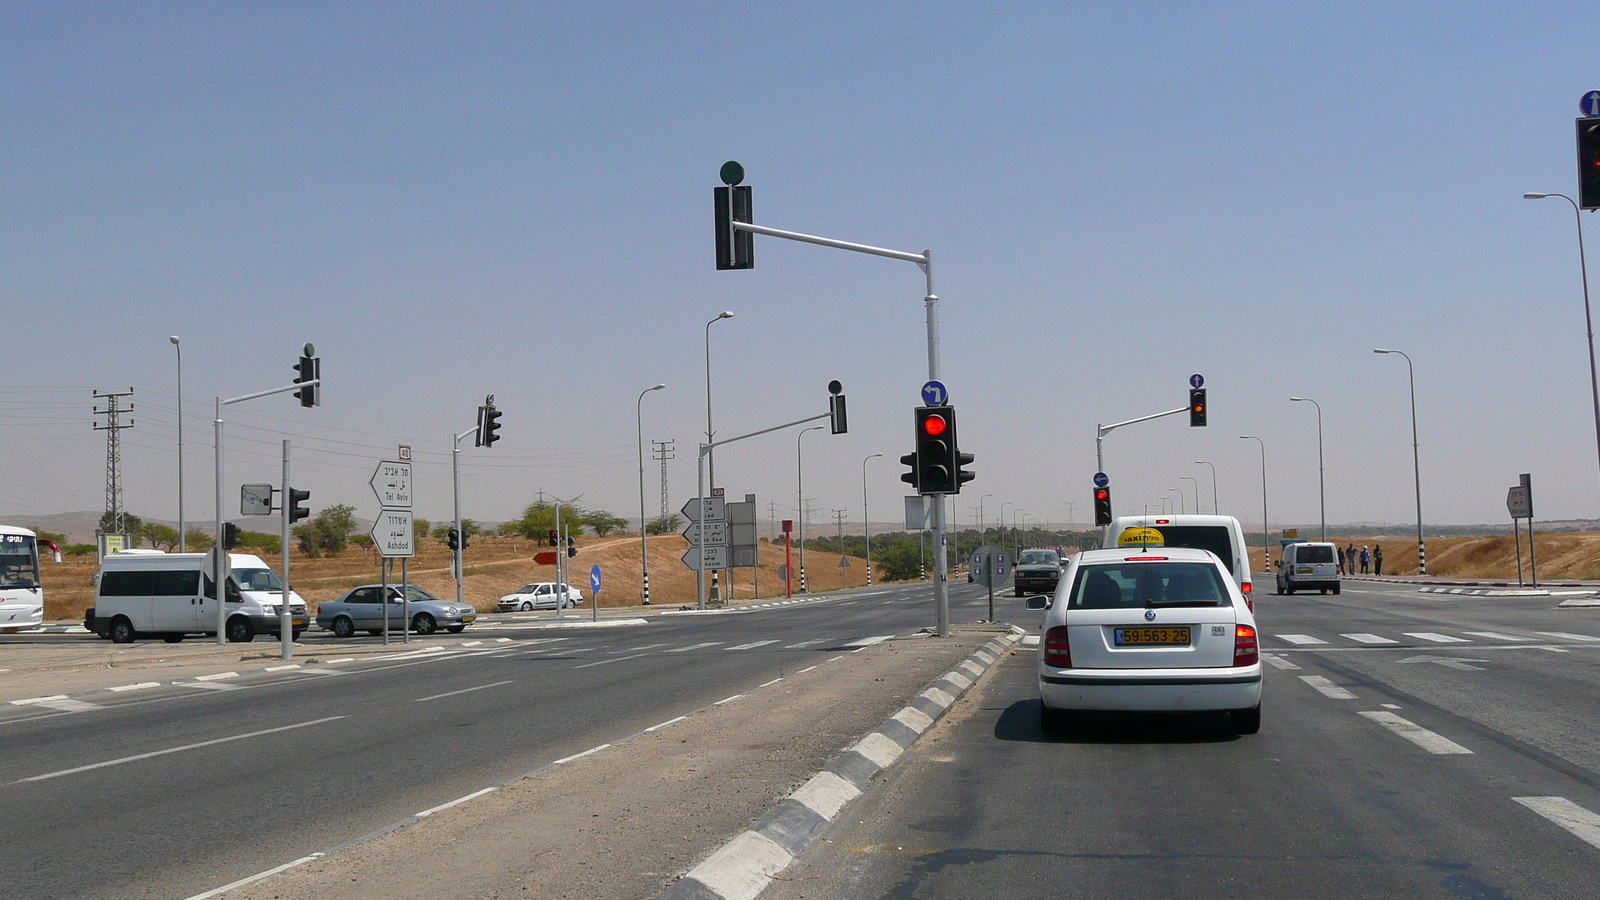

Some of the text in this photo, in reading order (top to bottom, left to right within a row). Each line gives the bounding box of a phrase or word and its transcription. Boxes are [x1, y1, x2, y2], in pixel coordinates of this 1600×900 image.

[402, 450, 408, 458] 40
[384, 466, 409, 477] תל אביב
[385, 491, 409, 502] Tel Aviv
[388, 516, 407, 524] אשדוד
[1124, 532, 1142, 542] taxi
[387, 541, 409, 550] Ashdod
